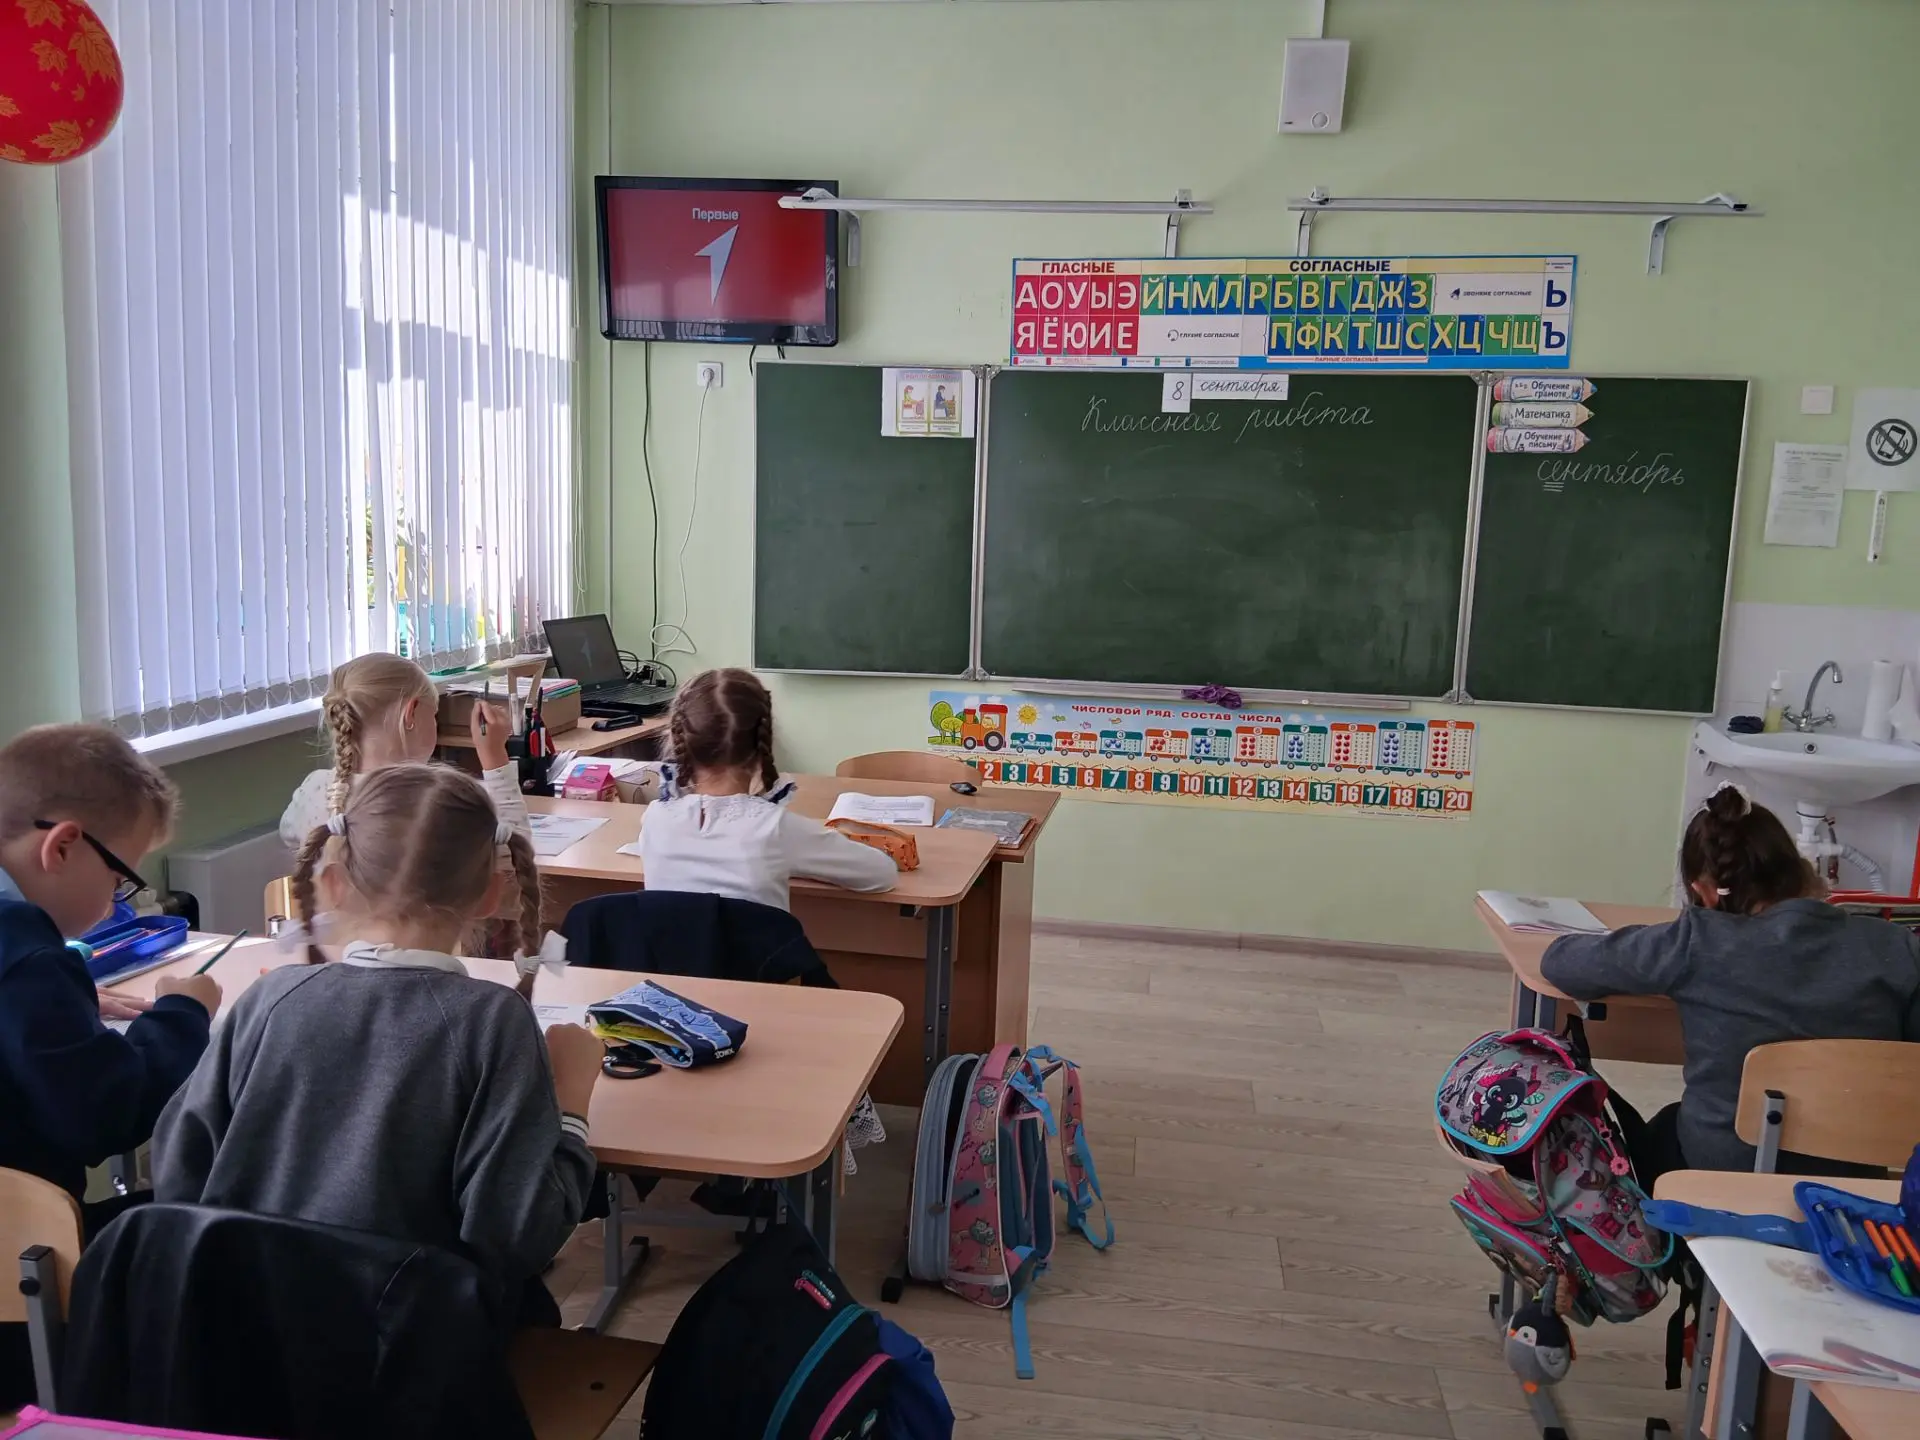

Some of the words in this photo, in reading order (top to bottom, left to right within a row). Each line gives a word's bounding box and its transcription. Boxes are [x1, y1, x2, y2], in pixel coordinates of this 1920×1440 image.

[692, 208, 738, 222] Первые
[1042, 262, 1114, 274] ГЛАСНЫЕ
[1290, 260, 1390, 272] СОГЛАСНЫЕ
[1172, 382, 1184, 400] 8
[1532, 380, 1570, 392] Обучение
[1534, 390, 1566, 399] грамоте
[1081, 395, 1222, 432] Классная
[1234, 392, 1374, 443] работа
[1515, 408, 1571, 420] Математика
[1524, 431, 1562, 442] Обучение
[1528, 440, 1558, 449] письму
[1072, 704, 1141, 716] ЧИСЛОВОЙ
[1147, 710, 1175, 718] РЯД.
[1181, 711, 1231, 720] СОСТАВ
[1238, 714, 1282, 723] ЧИСЛА
[984, 764, 994, 779] 2
[1009, 765, 1018, 780] 3
[1034, 766, 1044, 782] 4
[1059, 767, 1068, 782] 5
[1084, 769, 1094, 786] 6
[1109, 772, 1118, 788] 7
[1134, 774, 1144, 788] 8
[1160, 775, 1170, 790] 9
[1184, 776, 1200, 792] 10
[1208, 778, 1224, 794] 11
[1236, 780, 1252, 795] 12
[1260, 781, 1278, 798] 13
[1288, 782, 1304, 799] 14
[1314, 784, 1332, 800] 15
[1340, 786, 1358, 802] 16
[1366, 788, 1385, 804] 17
[1394, 788, 1413, 806] 18
[1421, 790, 1440, 808] 19
[1447, 792, 1468, 809] 20
